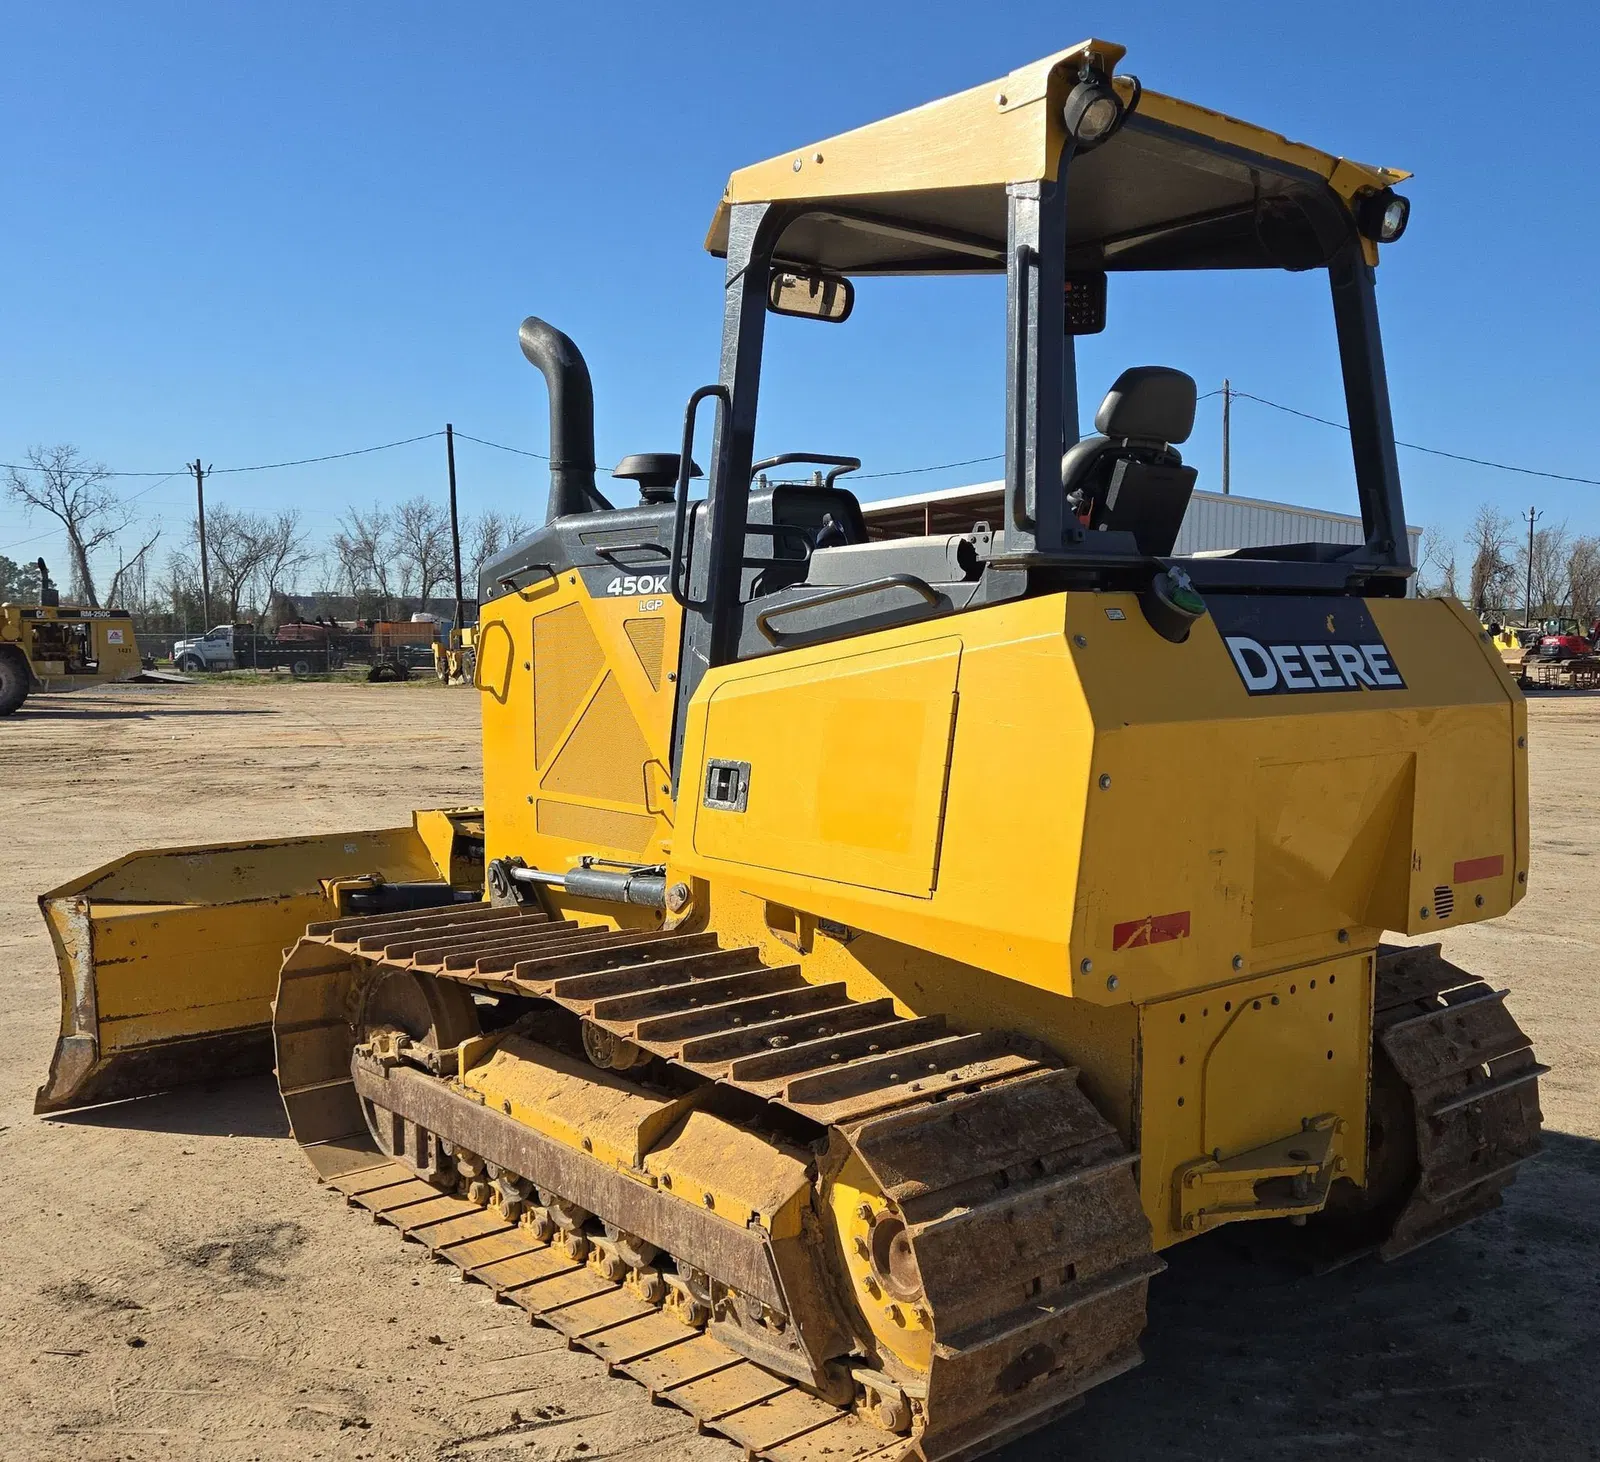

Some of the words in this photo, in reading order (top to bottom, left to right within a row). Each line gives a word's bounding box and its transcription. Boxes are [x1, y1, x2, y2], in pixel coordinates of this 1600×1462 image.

[607, 575, 668, 595] 450K
[639, 600, 663, 611] LGP
[1225, 636, 1402, 690] DEERE
